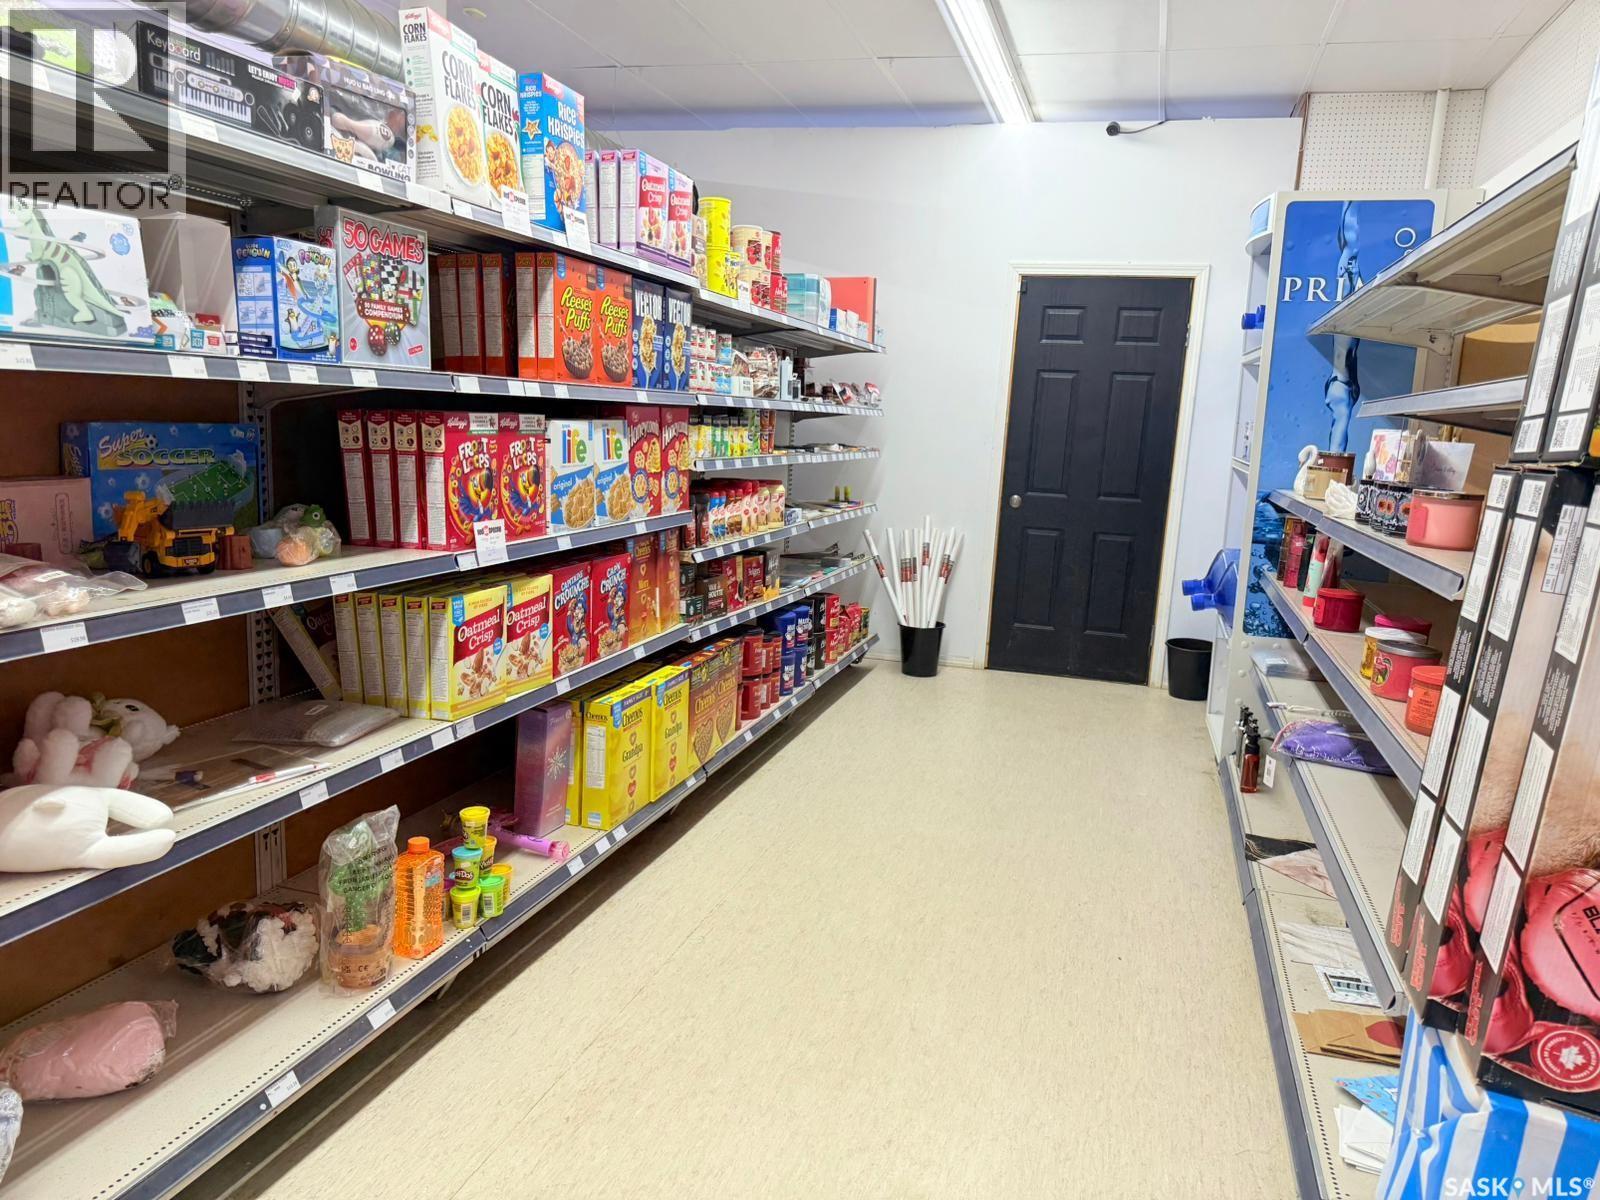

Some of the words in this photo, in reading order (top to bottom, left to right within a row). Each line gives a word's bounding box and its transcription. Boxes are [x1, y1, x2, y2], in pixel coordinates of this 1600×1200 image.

[402, 22, 426, 35] CORN
[403, 34, 427, 44] FLAKES
[147, 29, 201, 62] Keyboard
[247, 63, 263, 77] LET'S
[262, 68, 278, 82] ENJOY
[442, 50, 474, 89] CORN
[481, 81, 513, 116] CORN
[482, 105, 514, 136] FLAKES
[343, 217, 368, 252] 50
[368, 226, 425, 264] GAMES
[298, 248, 332, 270] PENGUIN
[560, 286, 592, 312] Reese's
[600, 295, 629, 319] Reese's
[635, 288, 662, 321] VECTOR
[565, 307, 591, 333] Puffs
[605, 315, 628, 339] Puffs
[99, 426, 145, 458] Super
[562, 428, 588, 464] life
[602, 427, 623, 461] life
[116, 447, 216, 467] SOCCER
[462, 452, 490, 474] LOOPS
[512, 451, 537, 471] LOOPS
[553, 479, 573, 491] original
[600, 567, 627, 595] CRUNCH
[506, 596, 546, 626] Oatmeal
[457, 609, 501, 642] Oatmeal
[515, 615, 541, 634] Crisp
[468, 629, 494, 650] Crisp
[663, 687, 683, 707] Cheerios
[622, 706, 644, 728] Cheerios
[664, 720, 683, 740] Grandpa
[622, 743, 644, 763] Grandpa
